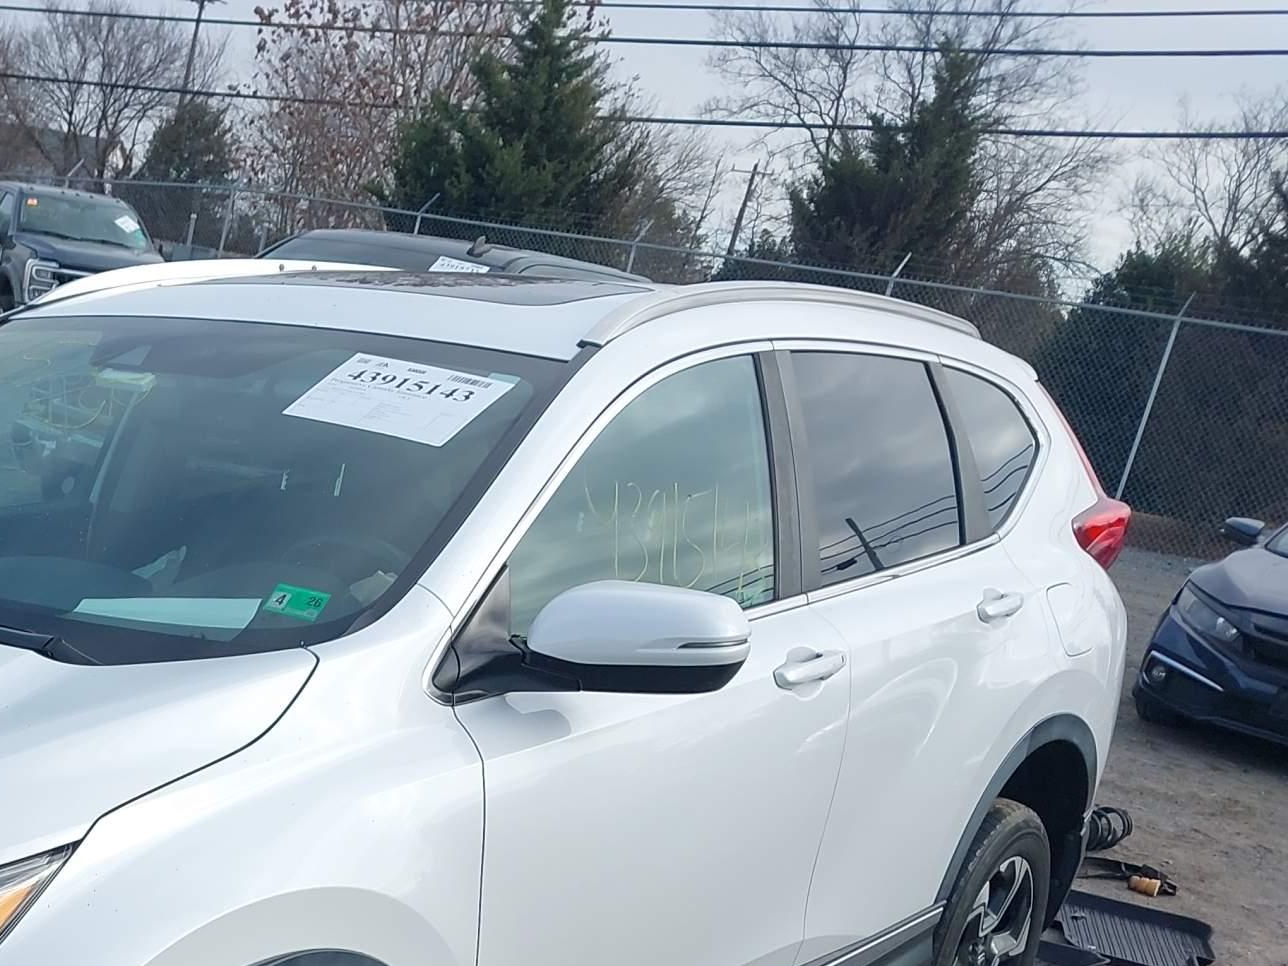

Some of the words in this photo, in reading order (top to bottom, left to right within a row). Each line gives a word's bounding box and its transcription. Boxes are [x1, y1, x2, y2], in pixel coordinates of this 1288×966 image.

[347, 369, 475, 402] 43915143
[275, 594, 287, 606] 4
[306, 596, 324, 608] 26
